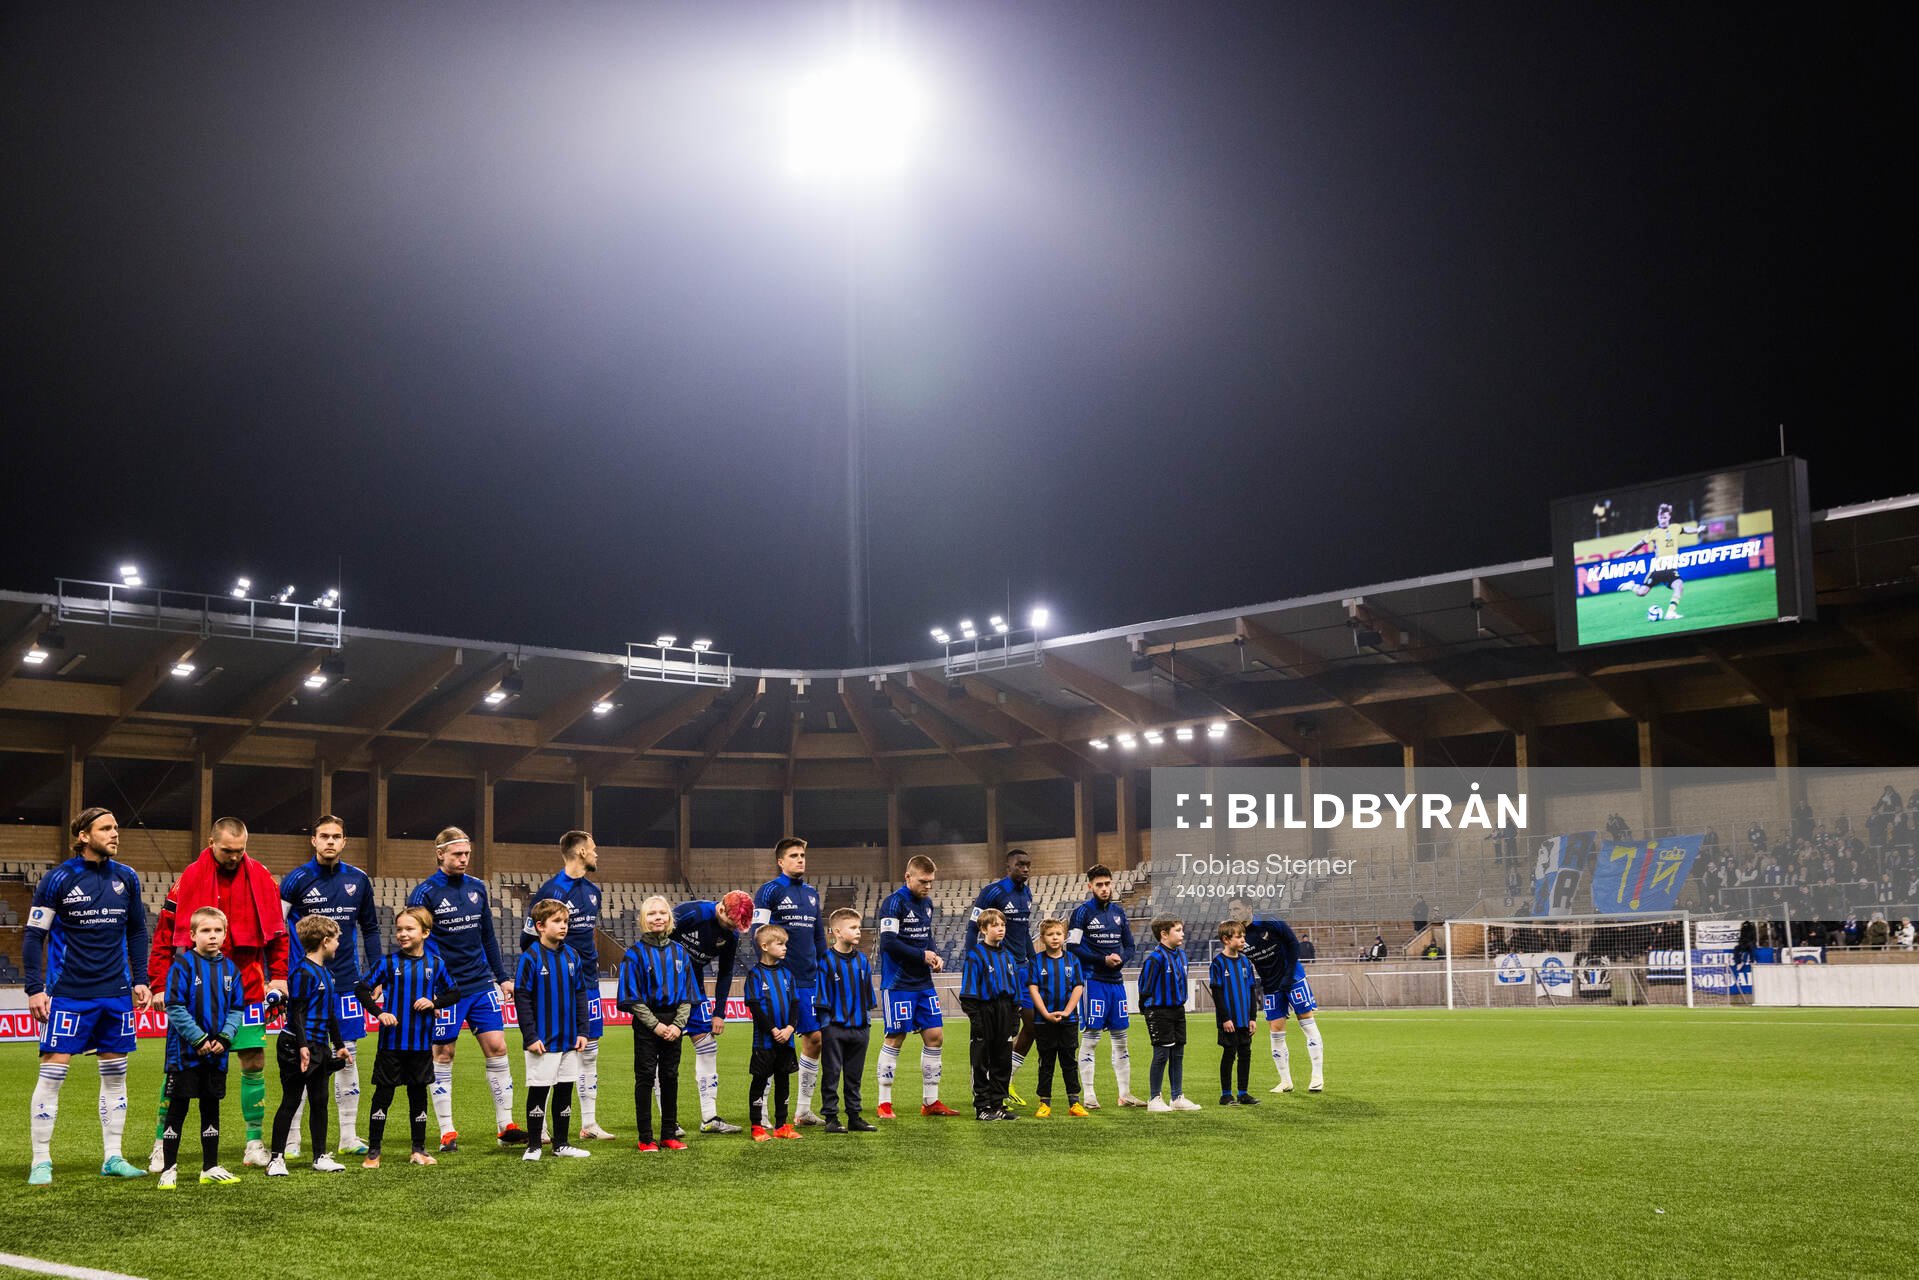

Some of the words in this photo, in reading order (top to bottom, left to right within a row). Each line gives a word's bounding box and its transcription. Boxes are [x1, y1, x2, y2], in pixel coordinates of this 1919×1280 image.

[1587, 560, 1647, 583] KÄMPA
[63, 895, 92, 904] stadium
[69, 909, 100, 917] HOLMEN
[434, 906, 458, 915] stadium
[439, 917, 464, 925] HOLMEN
[1087, 1017, 1095, 1025] 17
[435, 1026, 446, 1037] 20
[50, 1036, 58, 1048] 5
